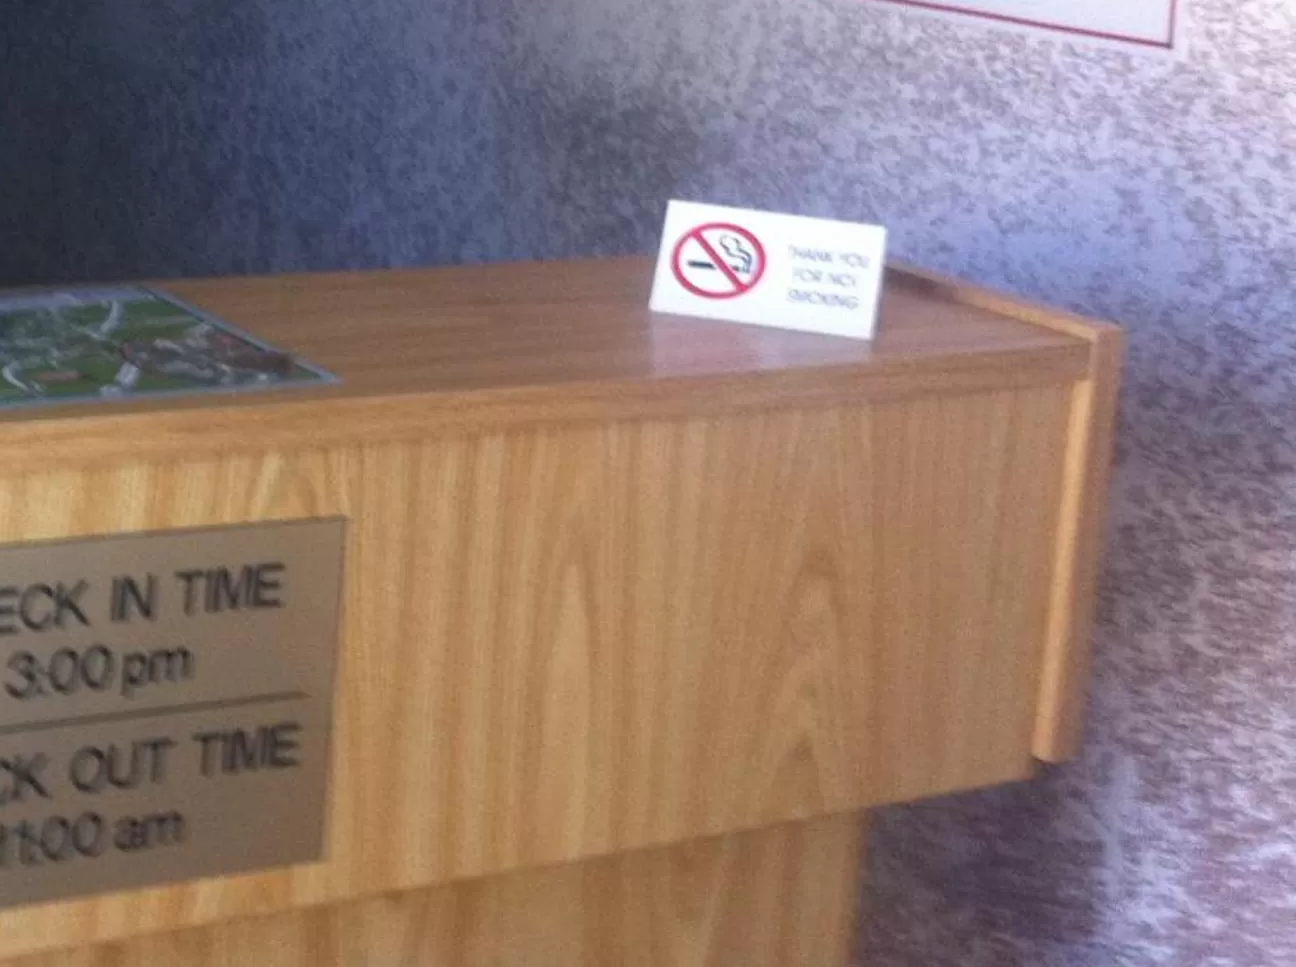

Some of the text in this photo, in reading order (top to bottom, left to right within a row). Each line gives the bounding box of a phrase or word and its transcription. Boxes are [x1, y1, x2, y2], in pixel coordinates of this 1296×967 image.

[787, 288, 860, 310] SMOKING
[111, 574, 157, 621] IN
[176, 562, 286, 615] TIME
[120, 646, 194, 698] pm
[68, 737, 177, 793] OUT
[193, 722, 302, 776] TIME
[113, 810, 186, 852] am
